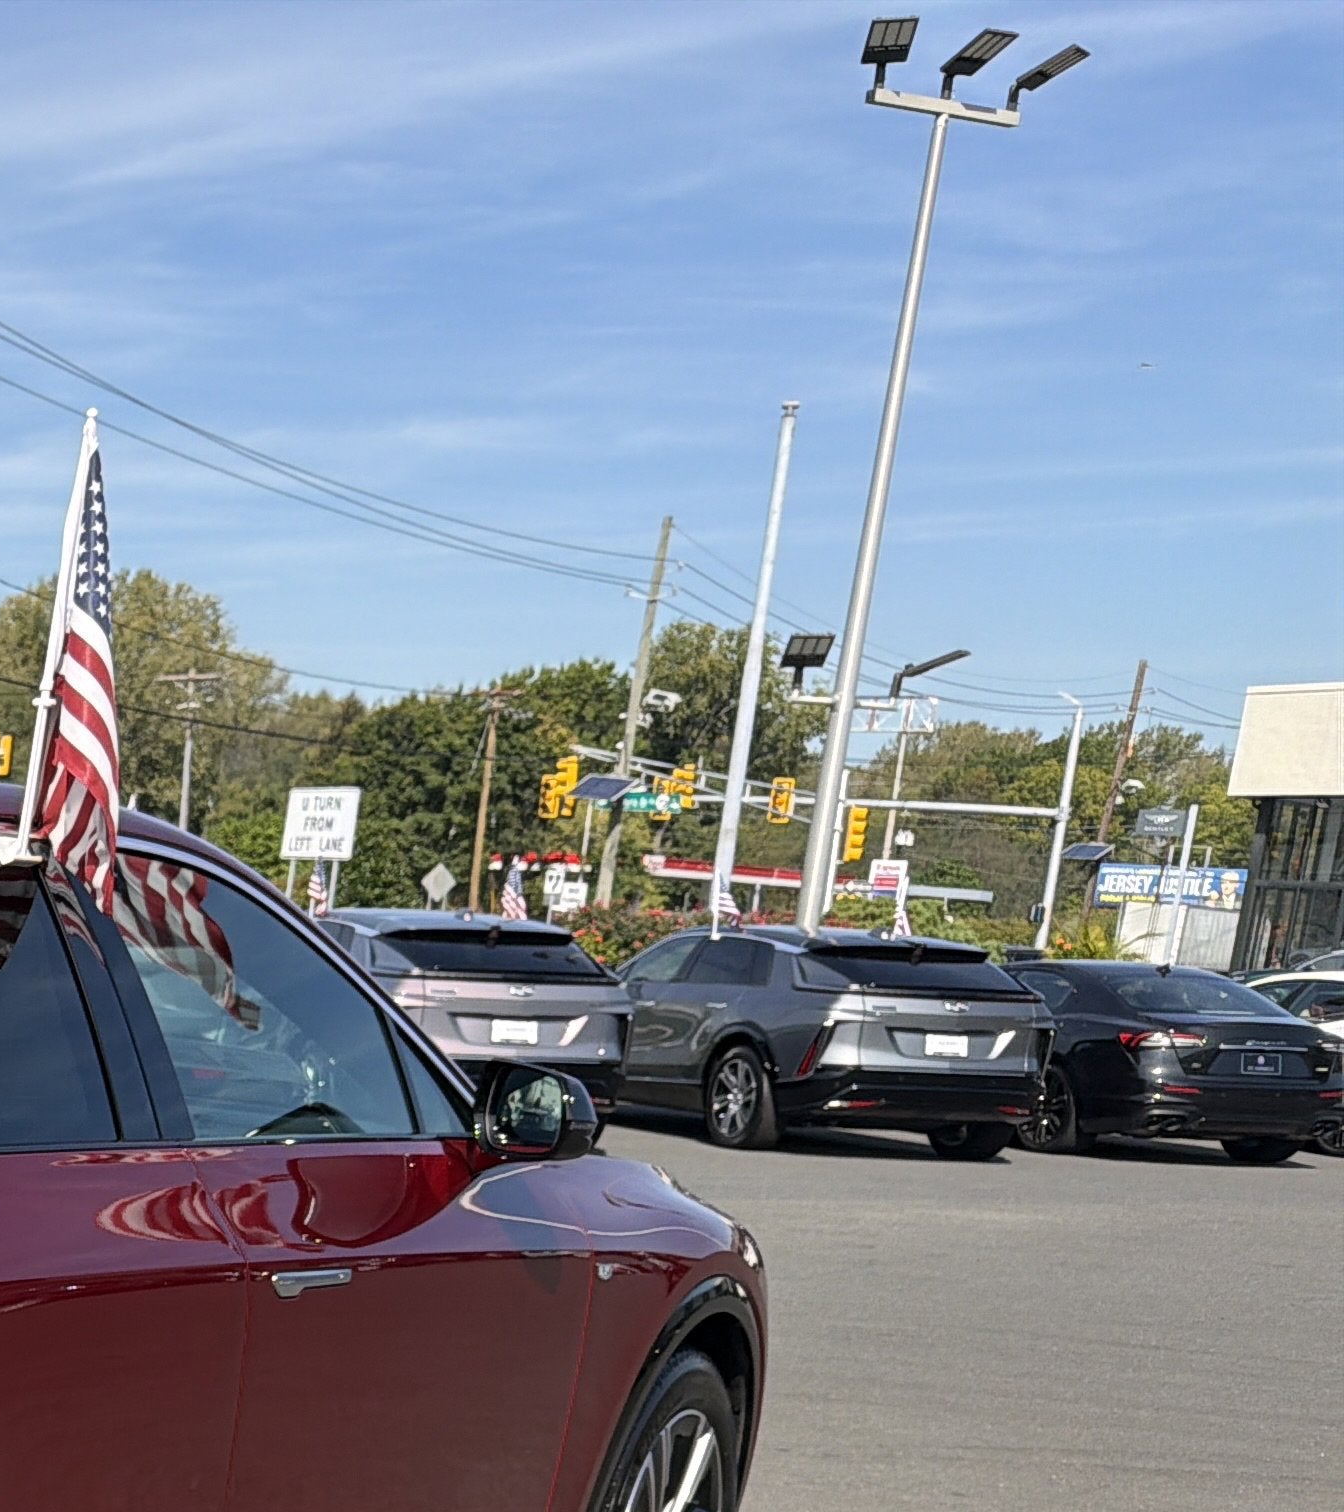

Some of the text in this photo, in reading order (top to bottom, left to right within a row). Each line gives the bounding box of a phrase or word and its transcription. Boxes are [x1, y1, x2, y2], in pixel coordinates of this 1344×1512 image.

[302, 795, 343, 812] U TURN
[303, 816, 334, 832] FROM
[289, 836, 345, 853] LEFT LANE
[1098, 874, 1153, 894] JERSEY
